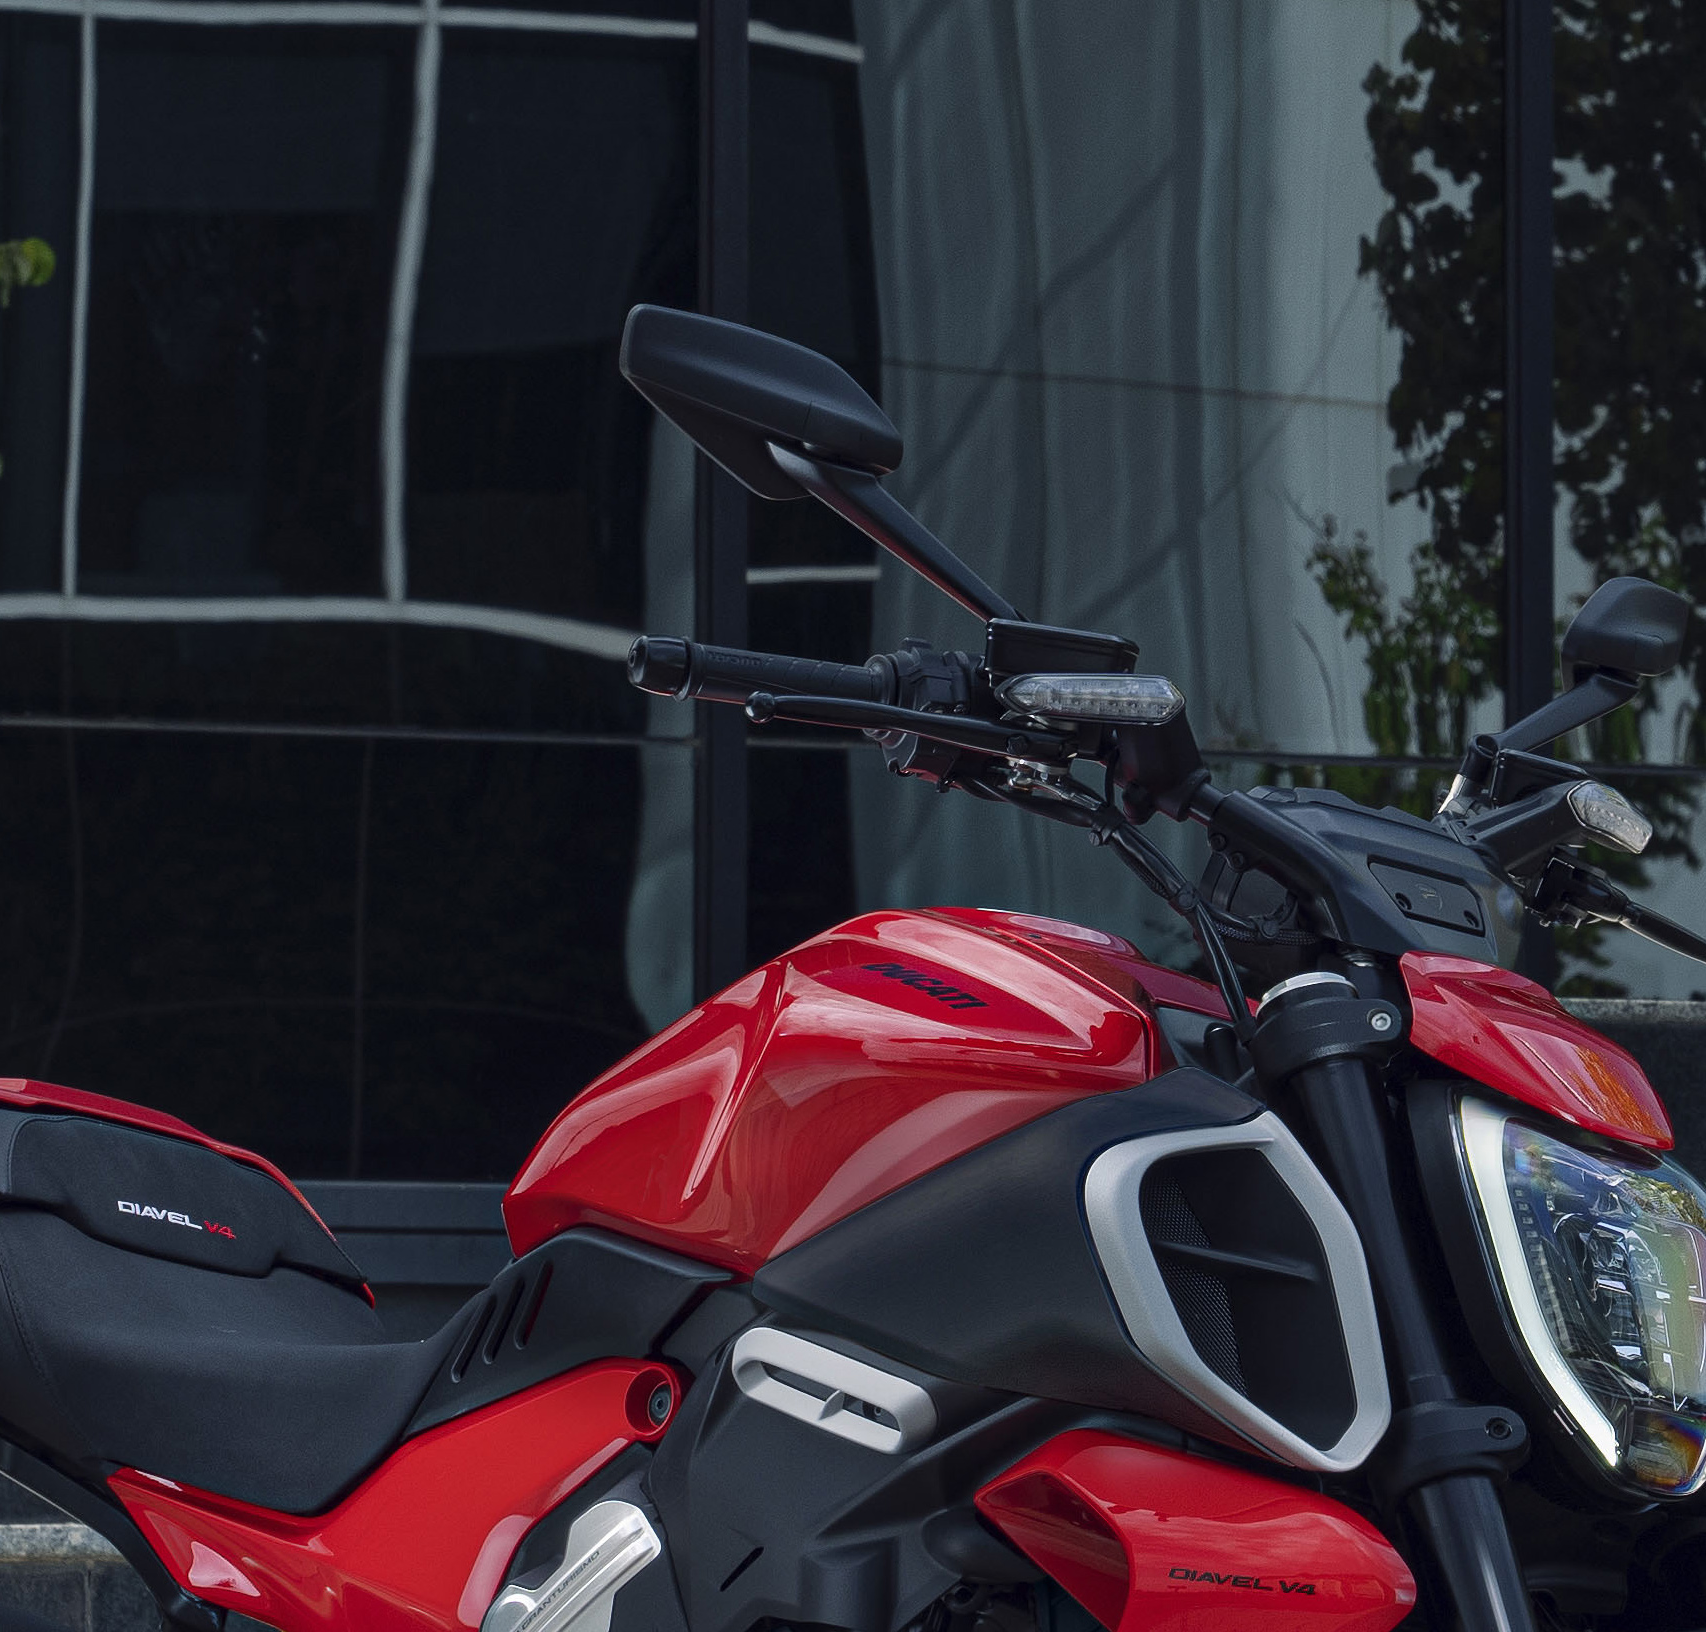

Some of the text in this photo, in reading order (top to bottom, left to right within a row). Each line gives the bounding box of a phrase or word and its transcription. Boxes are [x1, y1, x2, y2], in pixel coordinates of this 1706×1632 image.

[861, 962, 990, 1010] DUCATI
[117, 1200, 236, 1240] DIAVEL V4
[522, 1550, 600, 1630] GRANTURISMO
[1168, 1568, 1317, 1595] DIAVEL V4
